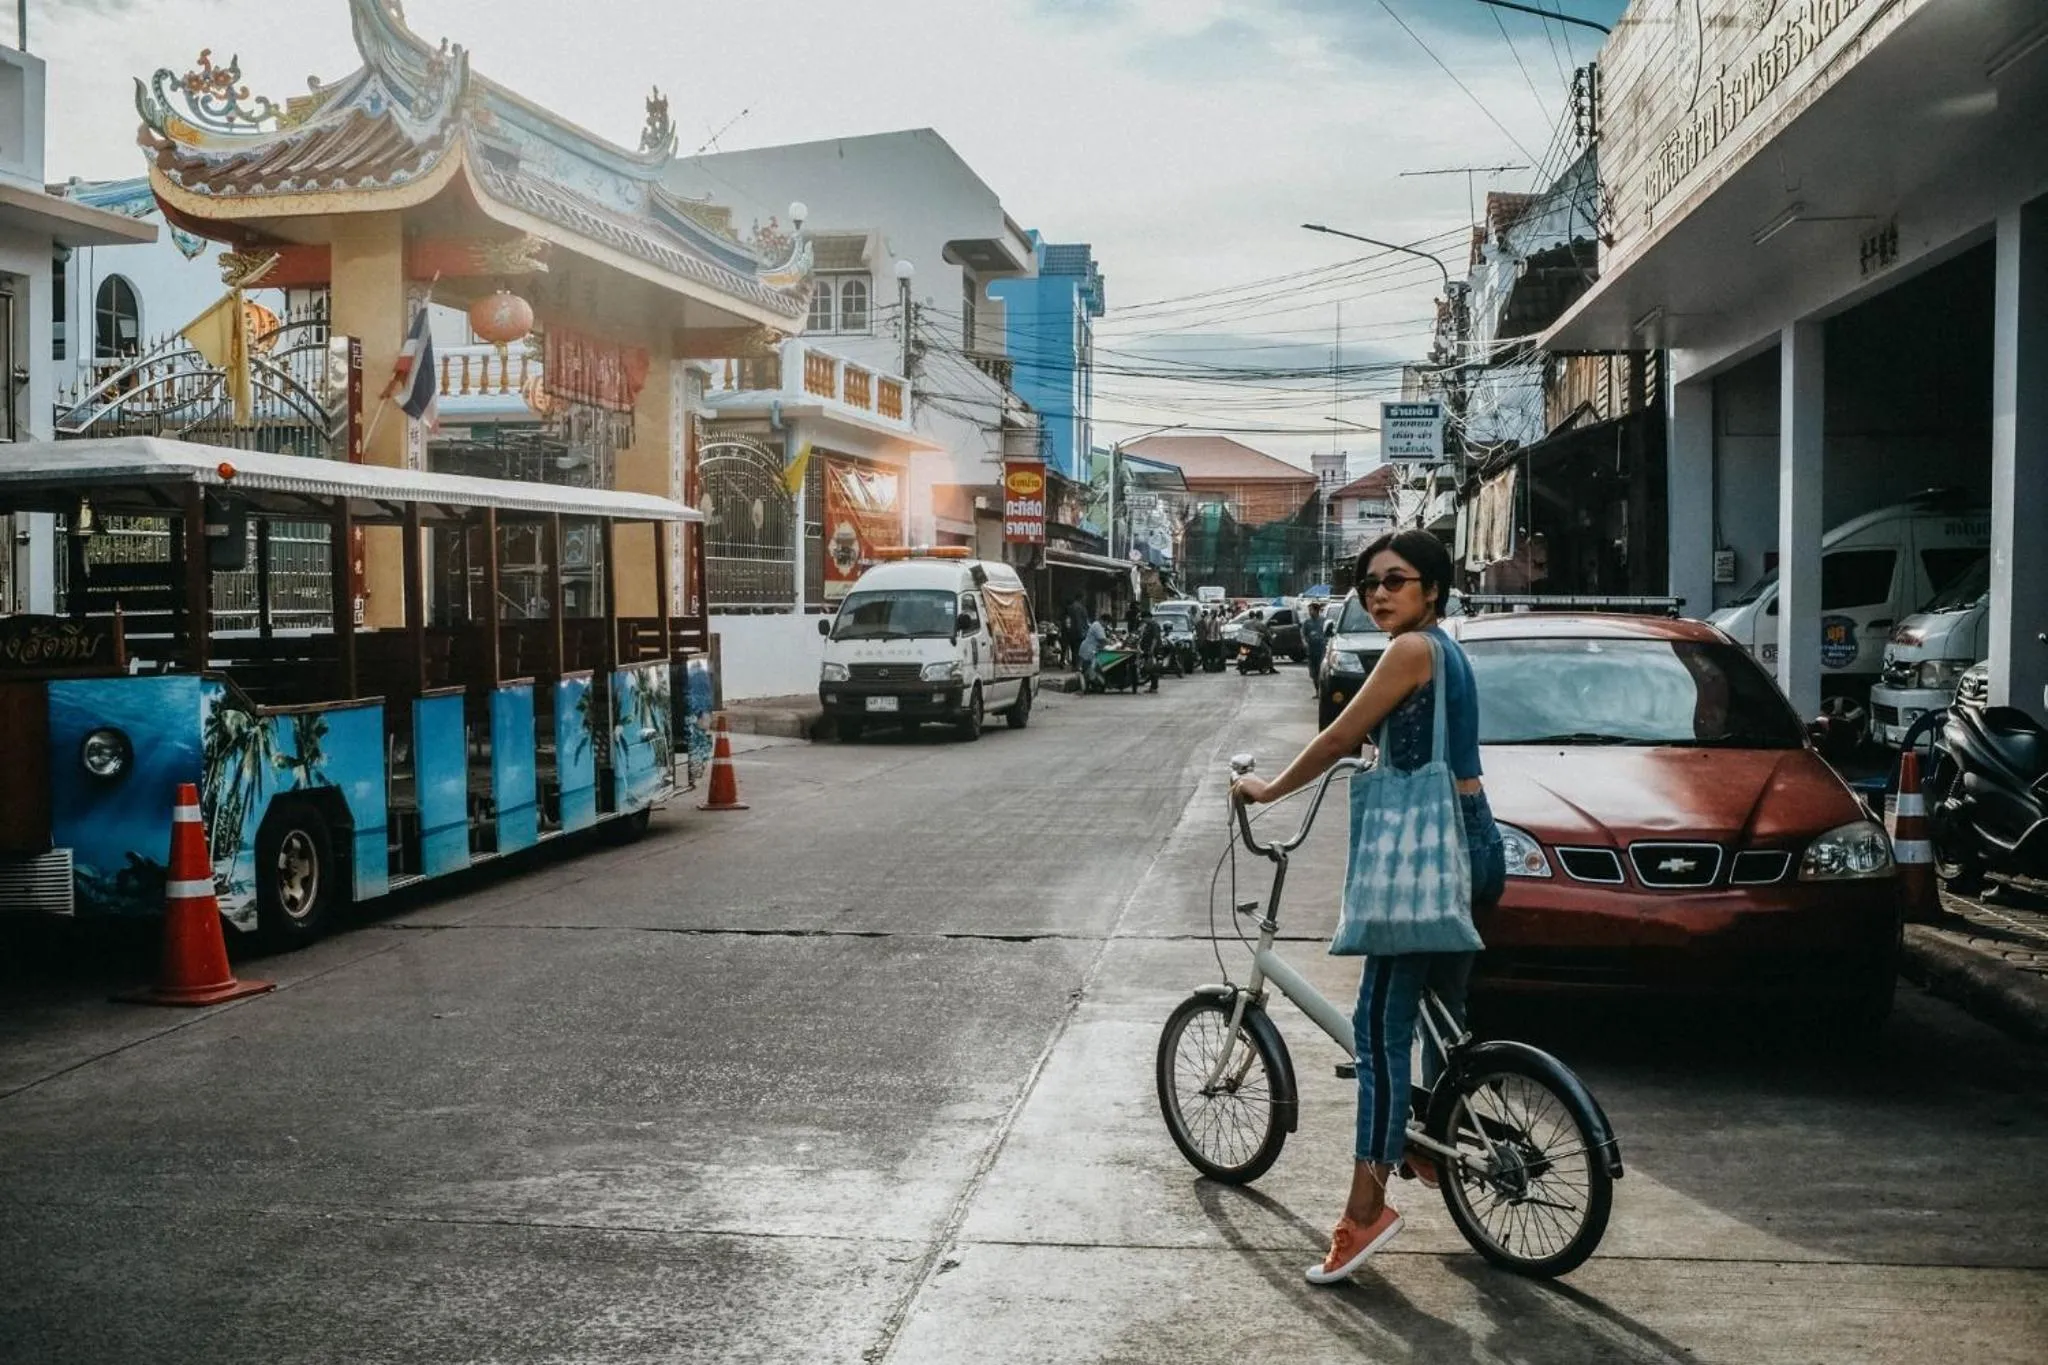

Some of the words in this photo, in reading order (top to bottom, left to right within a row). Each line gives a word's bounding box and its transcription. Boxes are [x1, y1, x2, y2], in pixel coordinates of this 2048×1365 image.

[1007, 496, 1042, 516] กะทิสด
[1007, 522, 1042, 541] ราคาถูก
